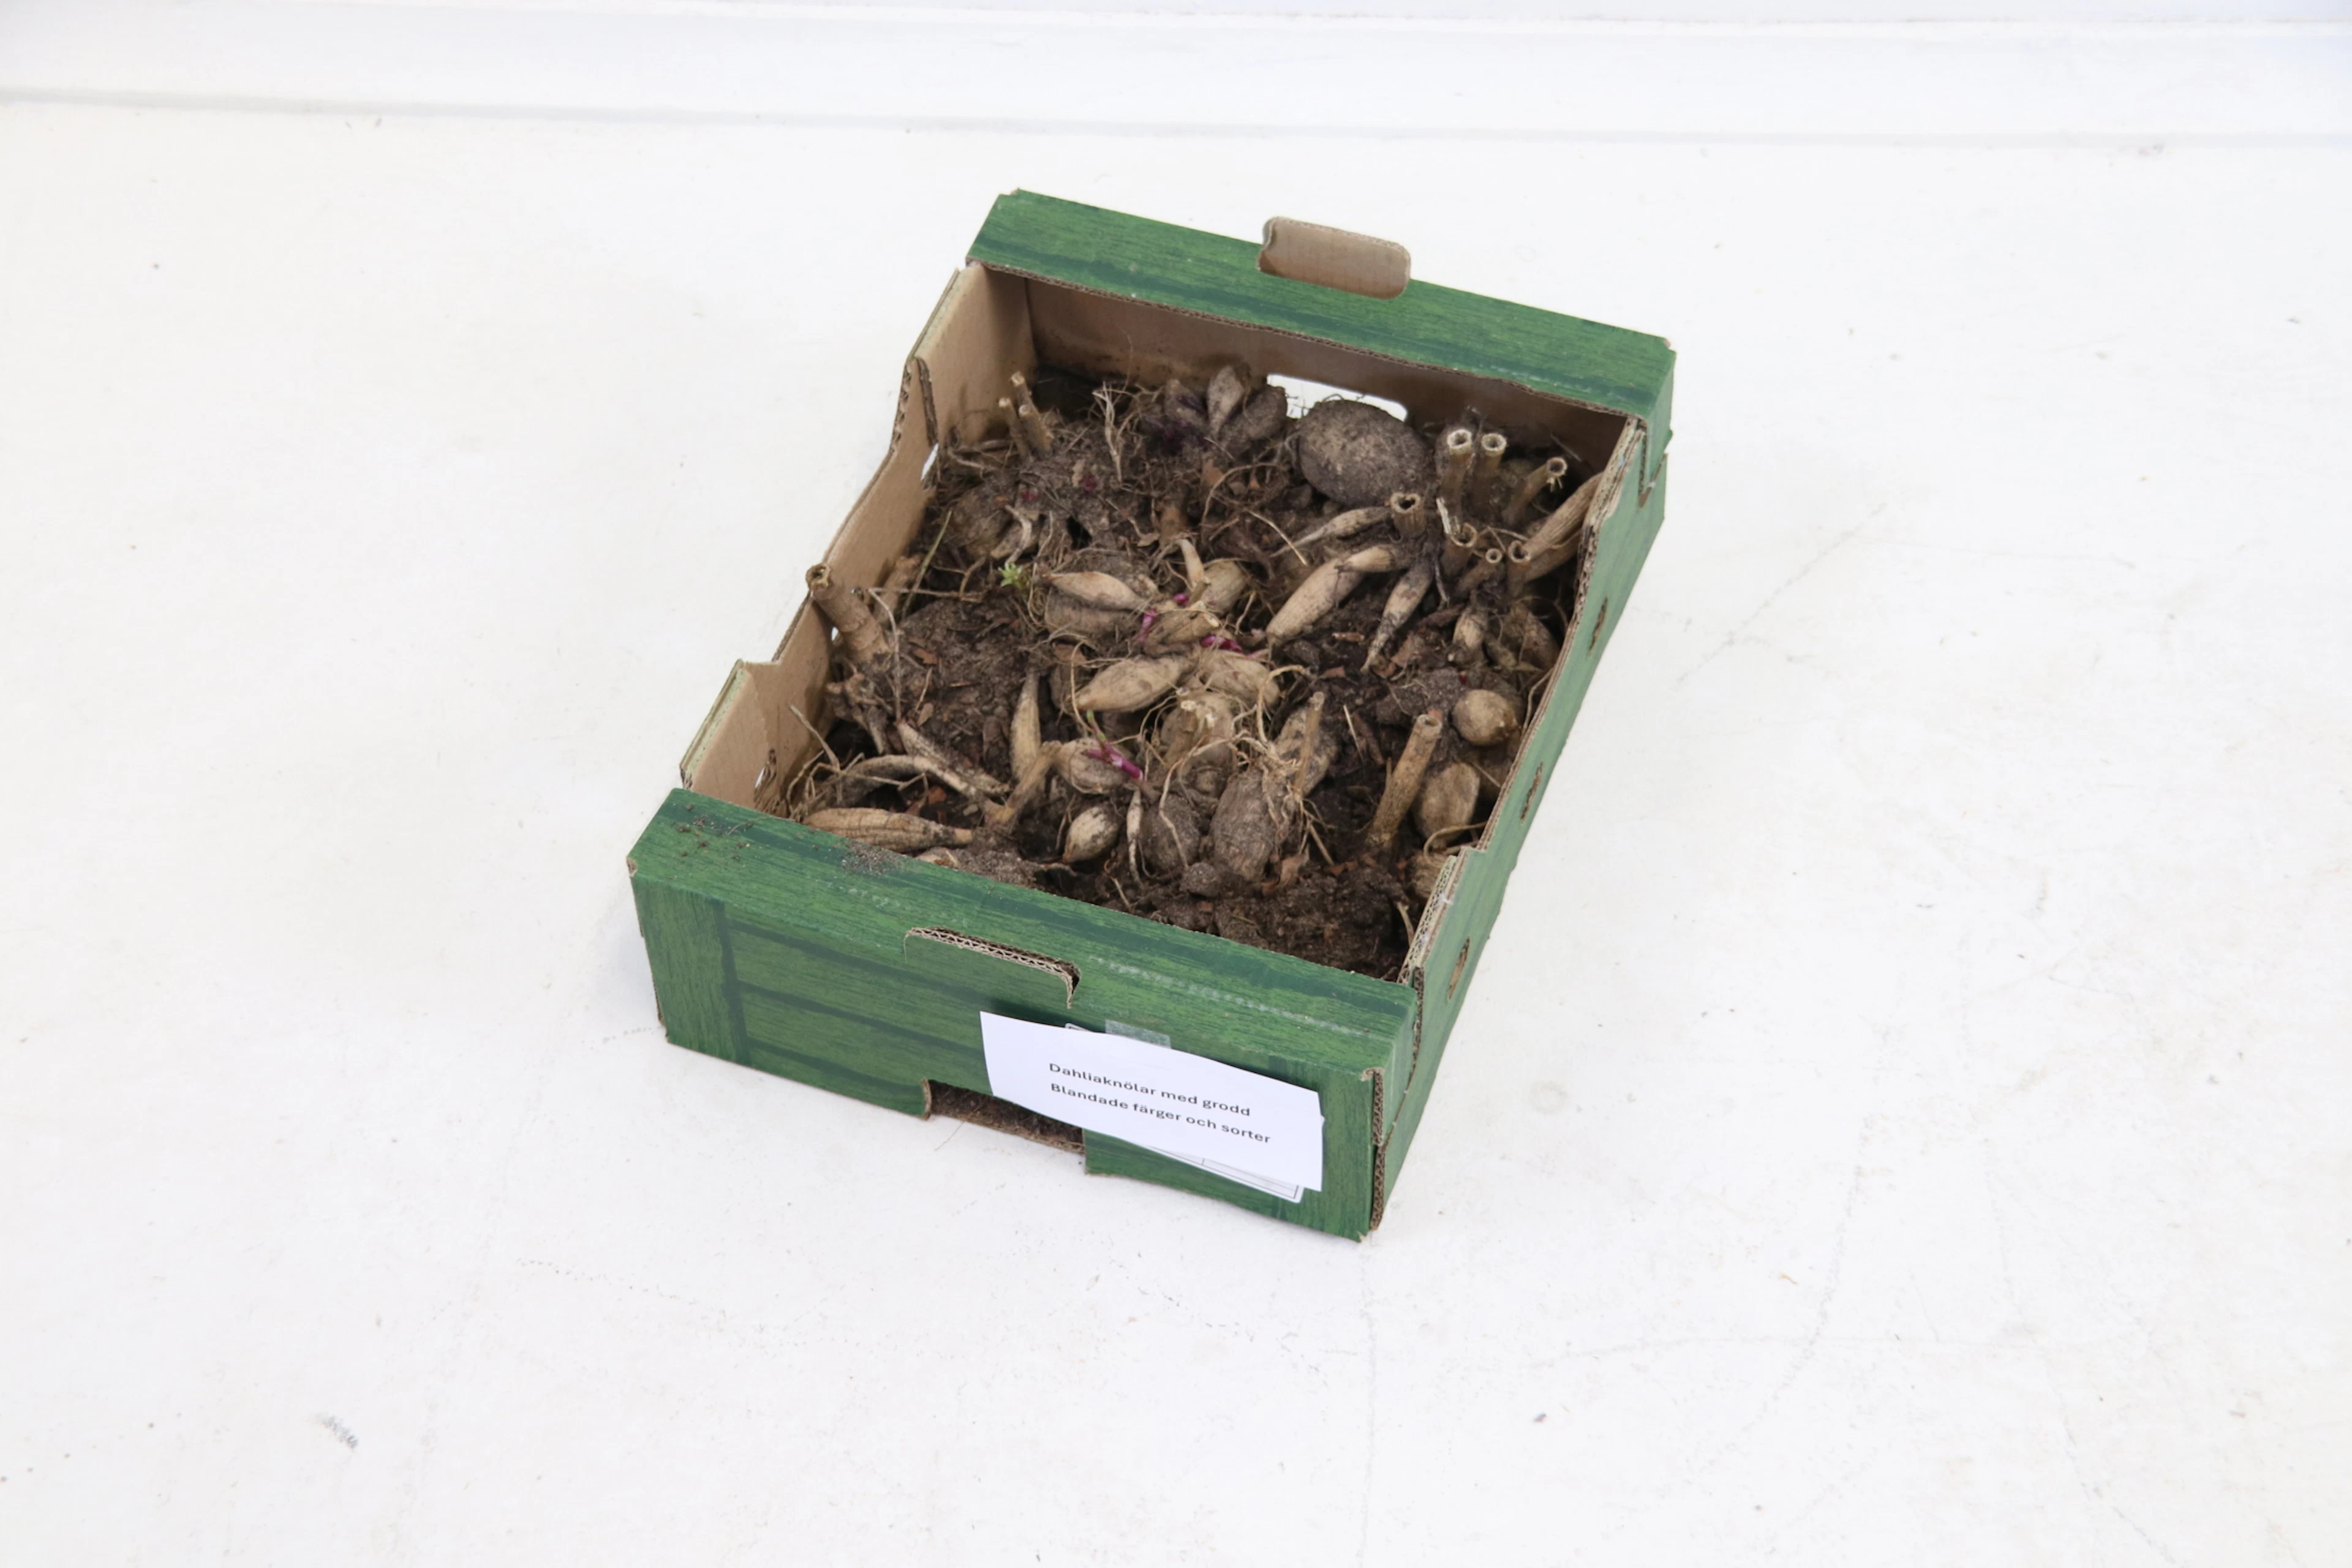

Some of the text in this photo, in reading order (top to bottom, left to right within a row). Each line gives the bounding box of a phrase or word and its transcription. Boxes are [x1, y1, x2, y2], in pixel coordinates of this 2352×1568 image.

[1049, 1063, 1251, 1117] Dahliaknölar med grodd
[1051, 1083, 1271, 1144] Blandade färger och sorter
